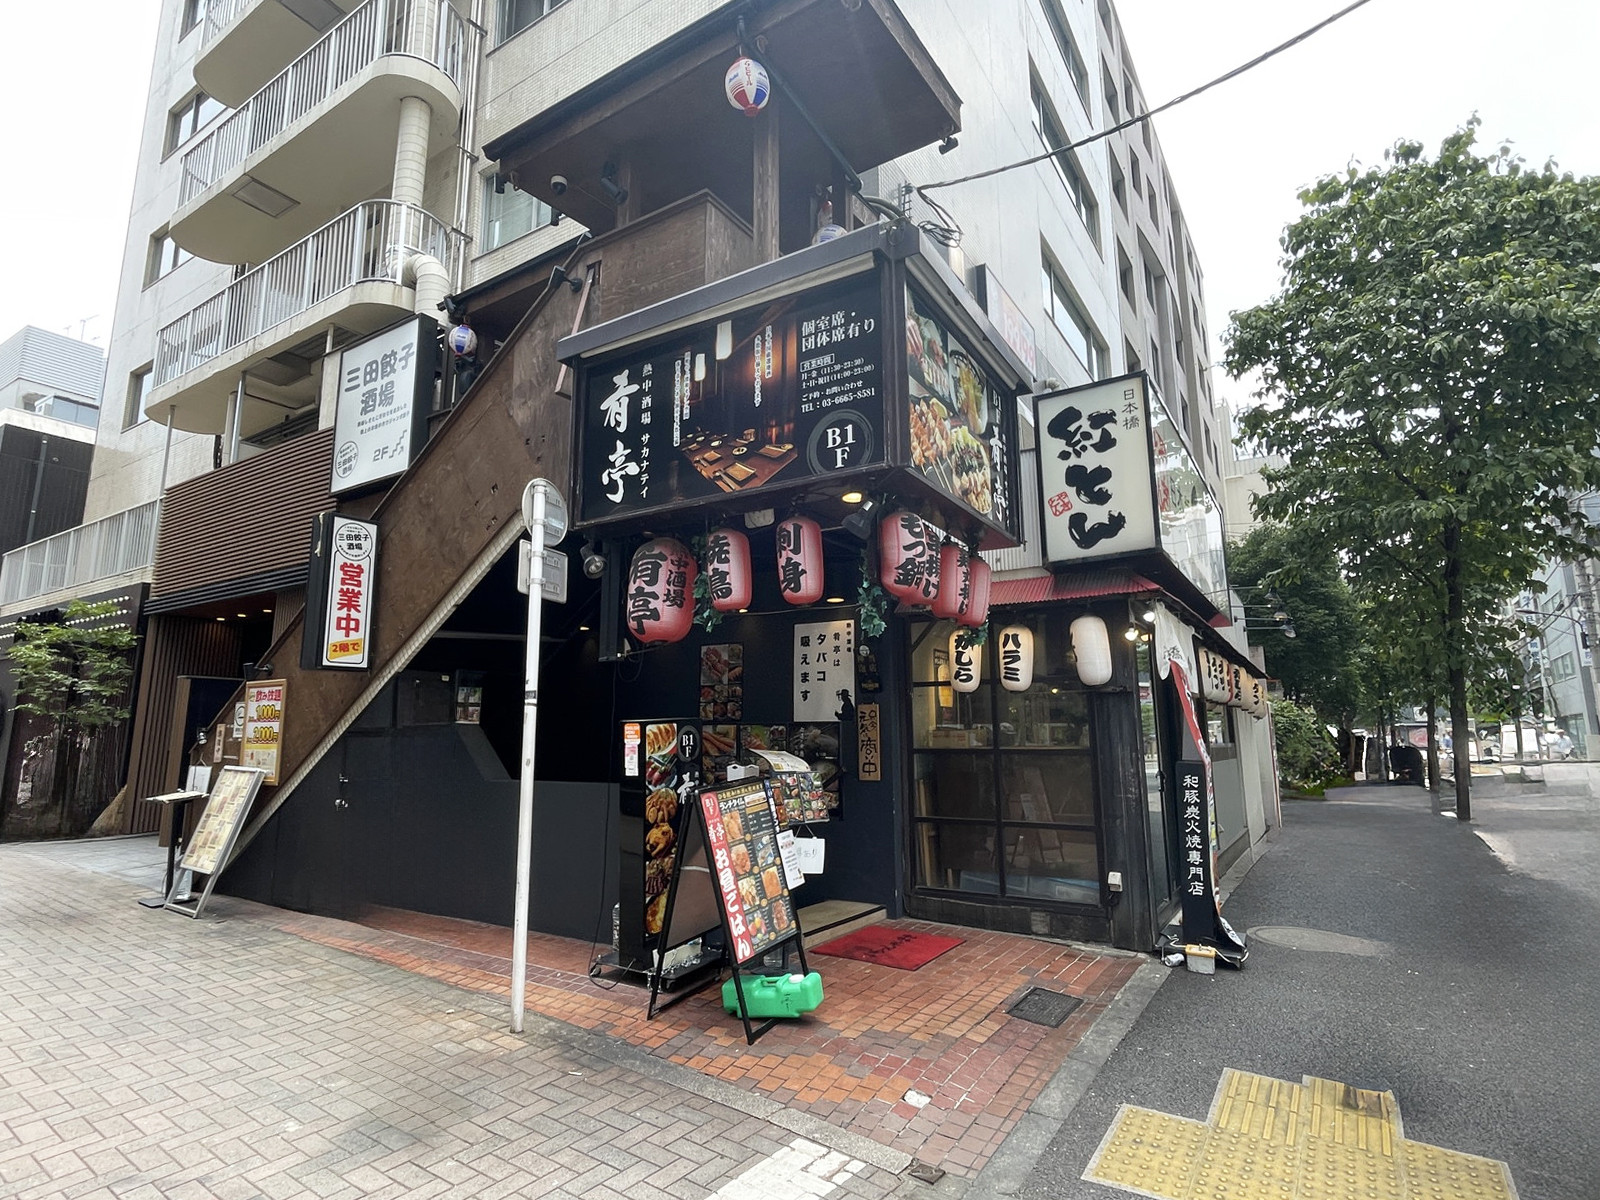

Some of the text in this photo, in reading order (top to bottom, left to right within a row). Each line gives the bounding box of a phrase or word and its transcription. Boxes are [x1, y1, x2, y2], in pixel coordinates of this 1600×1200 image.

[802, 318, 875, 352] 団体席有り
[344, 342, 415, 393] 三田餃子
[360, 380, 395, 416] 酒場
[641, 363, 653, 425] 熱中酒場
[1122, 388, 1140, 431] 日本橋
[373, 446, 389, 462] 2F
[600, 369, 641, 503] 肴亭
[826, 424, 856, 449] B1
[835, 446, 850, 468] F
[640, 433, 651, 498] サカナテイ
[338, 533, 369, 542] 三田餃子
[347, 542, 363, 551] 酒場
[776, 523, 807, 593] 刺身
[335, 562, 364, 638] 営業中
[332, 642, 360, 653] 2階で
[800, 635, 811, 702] 吸えます
[816, 633, 828, 682] タバコ
[833, 632, 841, 667] 肴亭は
[954, 634, 974, 683] かしら
[1002, 633, 1021, 682] ハラミ
[255, 689, 282, 702] 飲み放題
[682, 734, 694, 746] B1
[685, 746, 692, 757] F
[1183, 774, 1205, 896] 和豚炭火焼専門店
[715, 848, 751, 960] お昼ごはん
